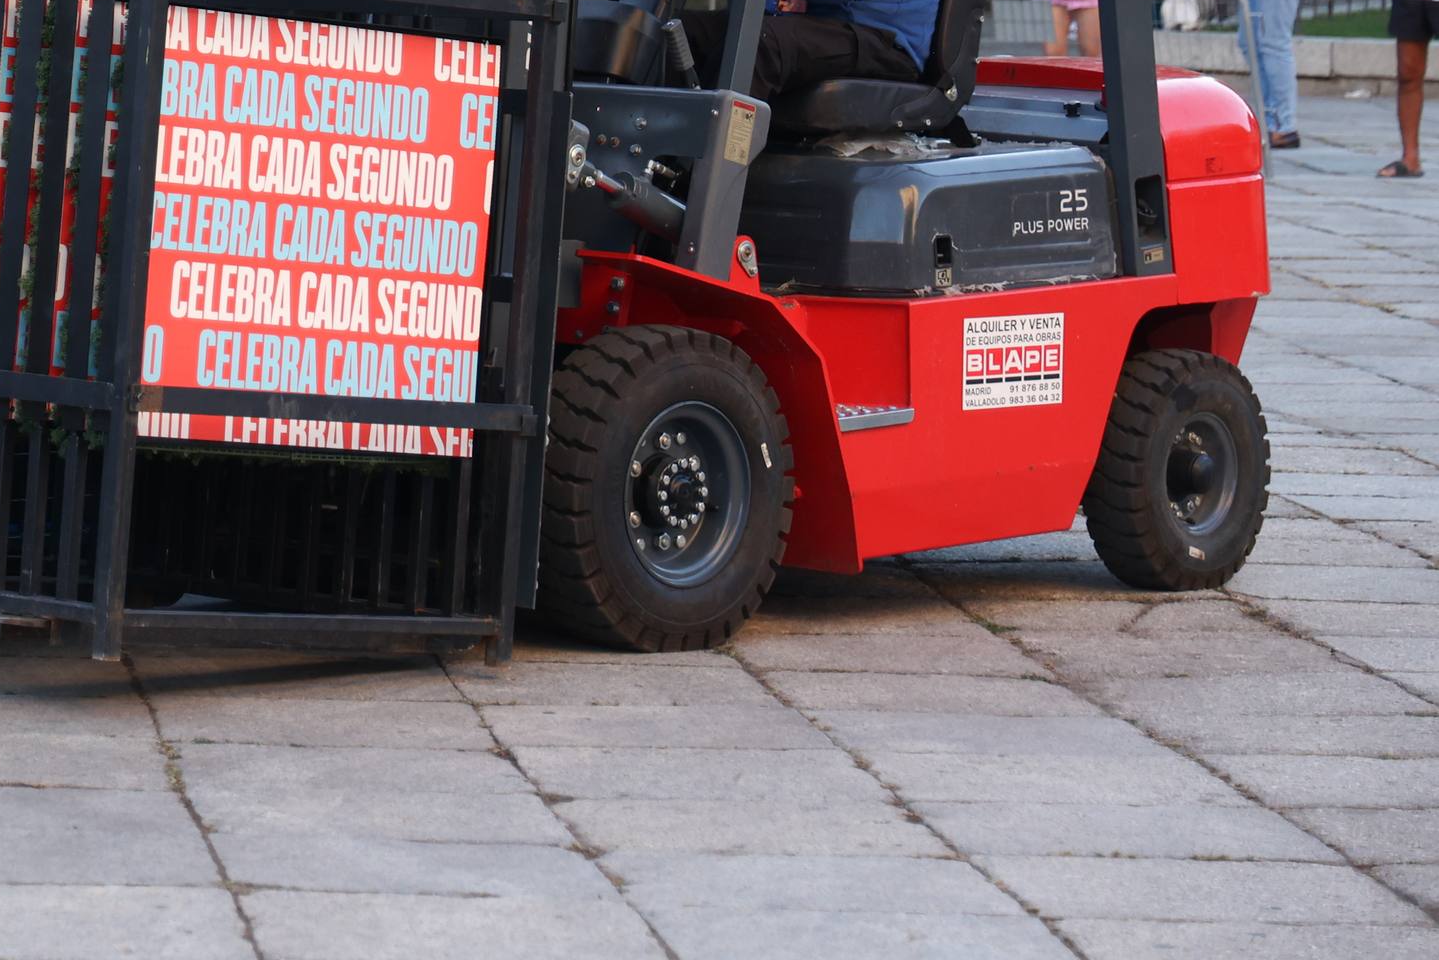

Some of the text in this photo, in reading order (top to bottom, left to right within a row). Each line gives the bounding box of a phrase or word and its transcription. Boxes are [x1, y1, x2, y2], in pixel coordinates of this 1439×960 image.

[197, 9, 270, 60] CADA
[276, 18, 403, 76] SEGUNDO
[223, 65, 296, 130] CADA
[301, 75, 429, 144] SEGUNDO
[248, 134, 320, 197] CADA
[327, 142, 454, 211] SEGUNDO
[1060, 189, 1089, 212] 25
[1013, 217, 1089, 236] PLUS POWER
[273, 203, 345, 266] CADA
[350, 210, 478, 278] SEGUNDO
[170, 260, 483, 342] CELEBRA CADA SEGUND
[967, 317, 1061, 334] ALQUILER Y VENTA
[966, 331, 1061, 346] DE EQUIPOS PARA OBRAS
[143, 324, 164, 384] O
[197, 328, 318, 395] CELEBRA
[324, 339, 396, 400] CADA
[967, 348, 1059, 373] BLAPE
[965, 387, 991, 396] MADRID
[1009, 385, 1019, 393] 91
[1021, 384, 1037, 393] 876
[1051, 382, 1060, 390] 50
[965, 393, 1060, 407] VALLADOLID 983 36 04 32
